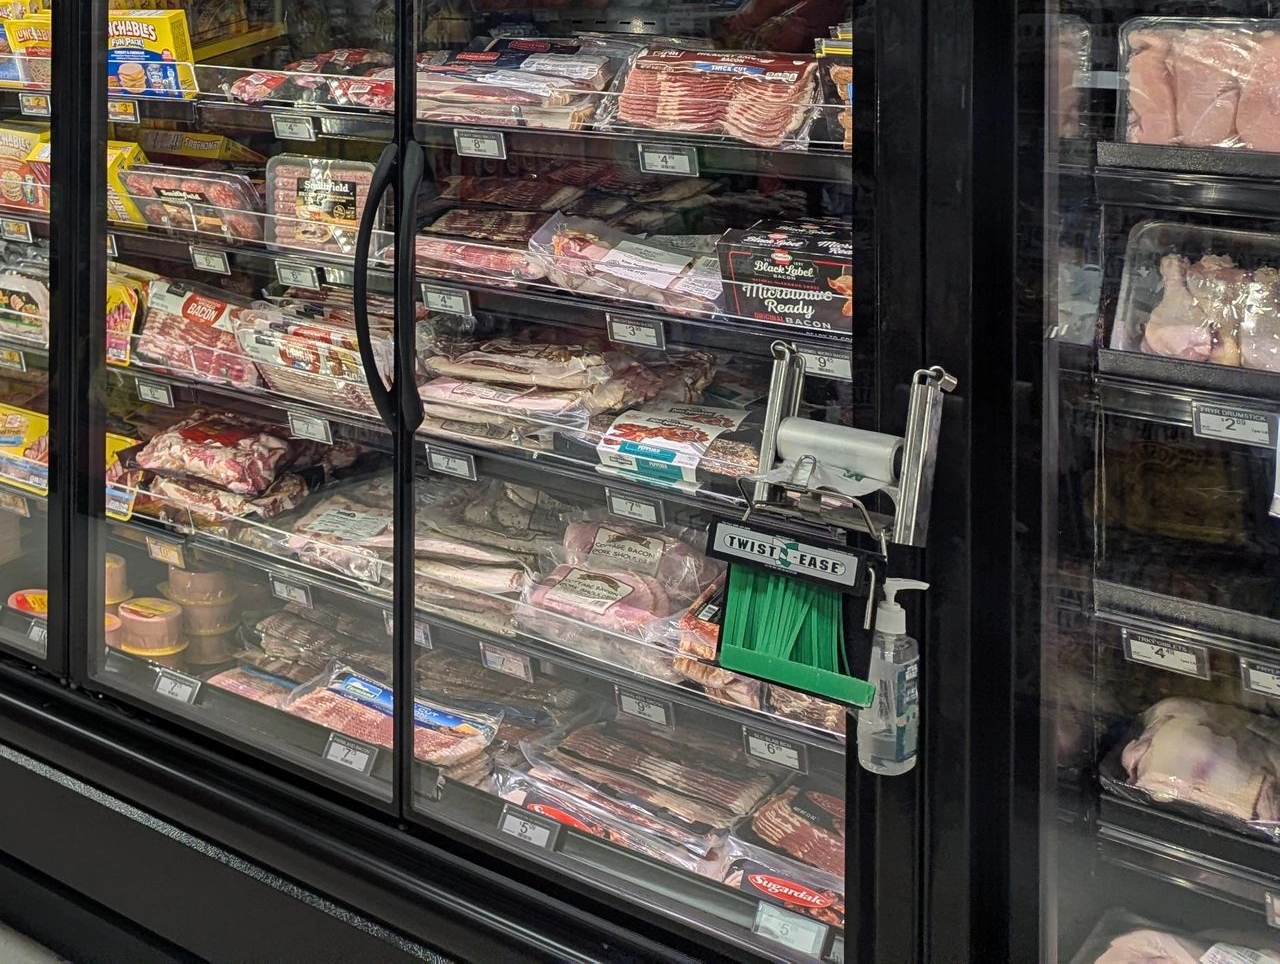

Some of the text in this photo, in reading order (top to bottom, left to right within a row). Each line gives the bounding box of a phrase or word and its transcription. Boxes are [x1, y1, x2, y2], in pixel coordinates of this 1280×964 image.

[111, 38, 125, 47] FUN
[711, 64, 732, 72] THICK
[304, 180, 349, 194] Smithfield
[161, 190, 202, 200] Smithfield
[754, 260, 815, 278] Black Label
[187, 303, 217, 320] BACON
[765, 298, 816, 319] Ready
[785, 317, 832, 330] BACON
[1221, 410, 1267, 422] DRUMSTICK
[595, 542, 656, 558] COTTAGE BACON
[728, 535, 777, 557] TWIST
[752, 876, 826, 906] Sugardale
